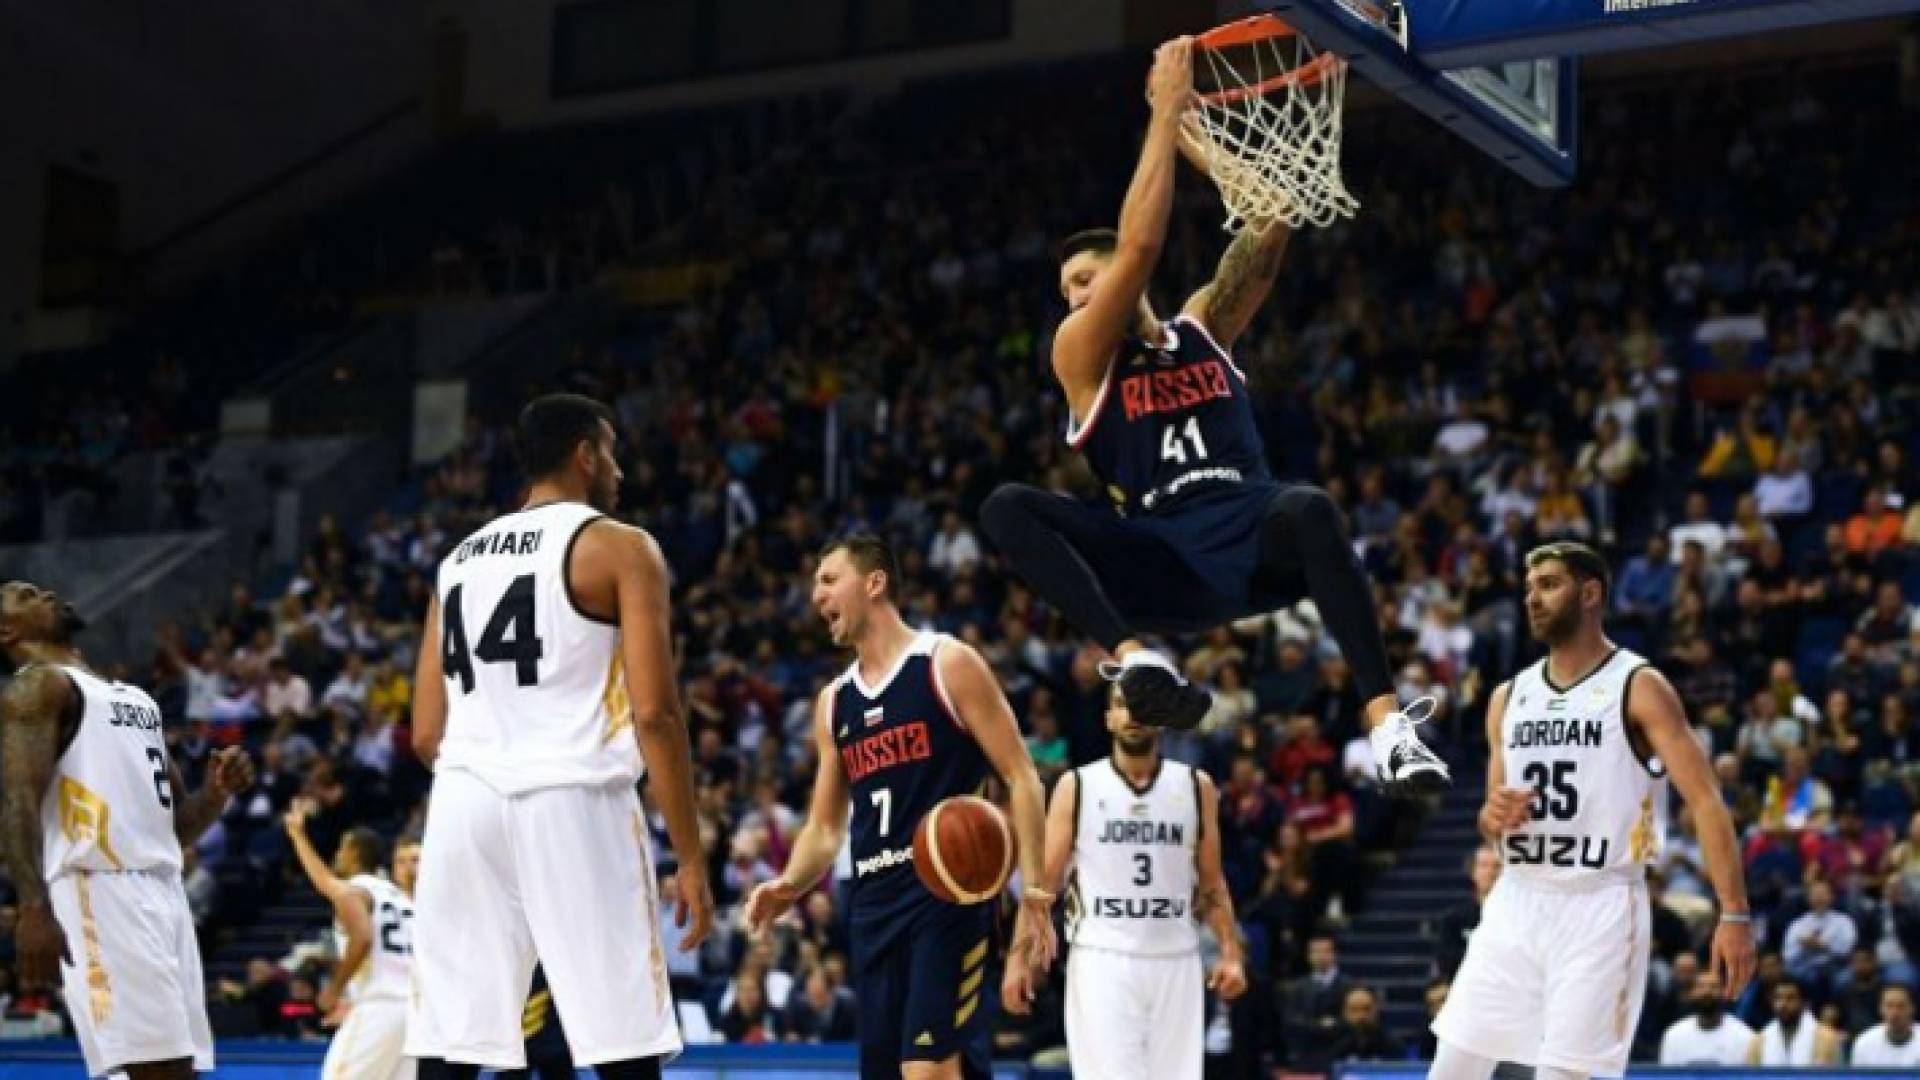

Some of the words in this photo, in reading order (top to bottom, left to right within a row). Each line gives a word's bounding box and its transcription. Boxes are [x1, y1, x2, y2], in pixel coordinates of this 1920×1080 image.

[1161, 416, 1208, 465] 41
[442, 572, 543, 695] 44
[109, 701, 161, 732] JORDA
[1509, 719, 1602, 748] JORDAN
[1522, 760, 1578, 821] 35
[870, 788, 892, 837] 7
[1097, 820, 1184, 846] JORDAN
[1506, 834, 1609, 869] SUZU
[1133, 852, 1153, 887] 3
[1095, 897, 1185, 919] ISUZU
